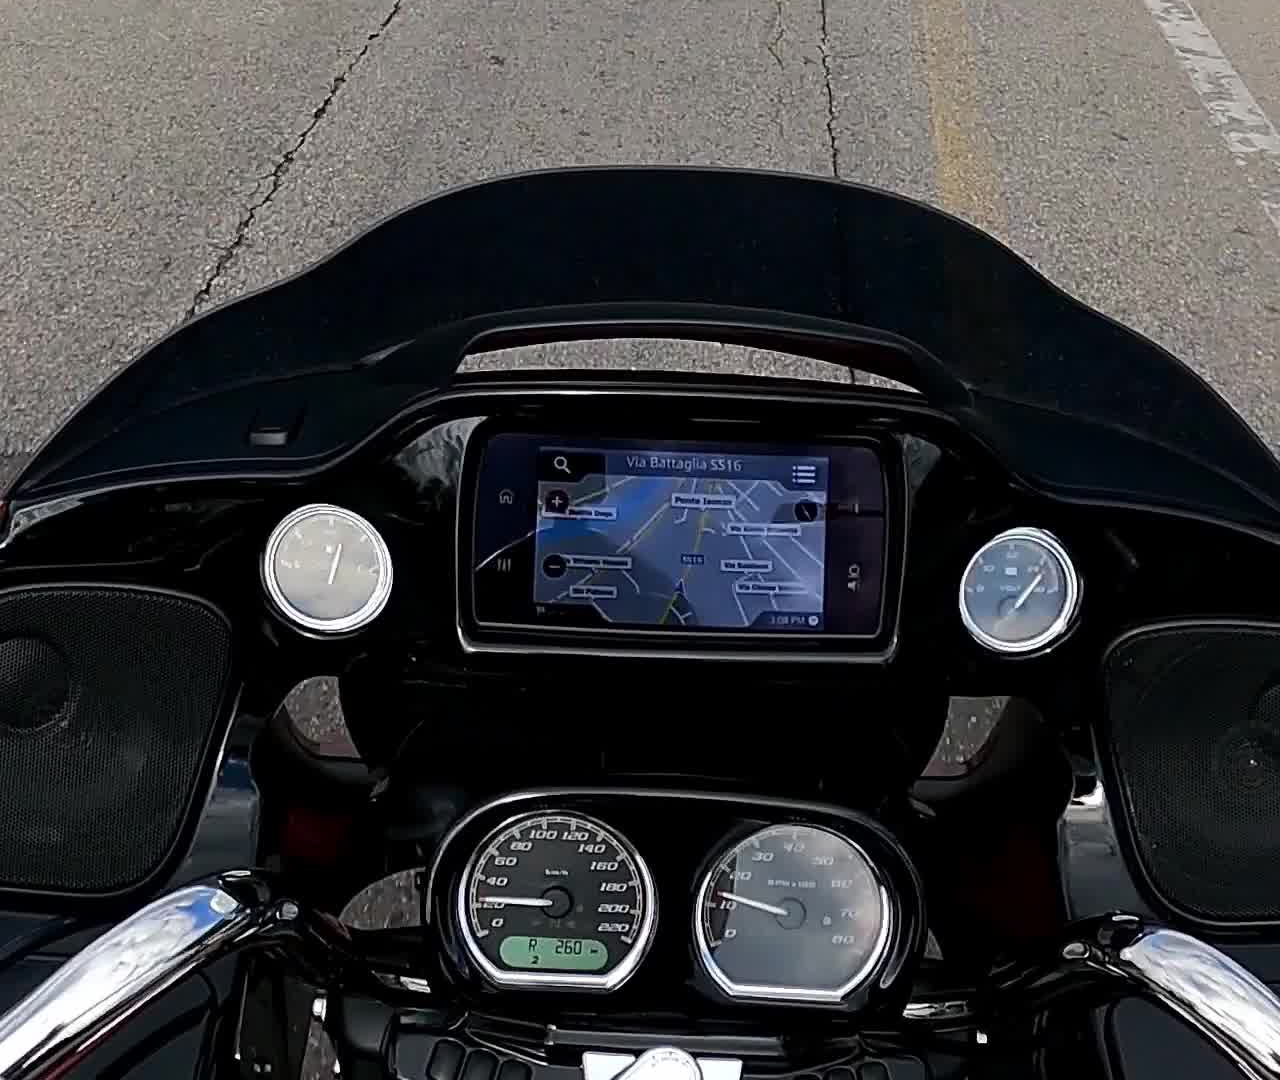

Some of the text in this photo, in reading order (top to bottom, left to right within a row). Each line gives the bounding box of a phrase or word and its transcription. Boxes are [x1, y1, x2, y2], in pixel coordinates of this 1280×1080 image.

[626, 455, 742, 473] Via Battaglia SS16
[529, 830, 557, 840] 100
[561, 831, 589, 841] 120
[510, 842, 532, 851] 80
[578, 844, 606, 854] 140
[783, 842, 806, 853] 40
[494, 857, 517, 866] 60
[752, 852, 775, 862] 30
[590, 861, 618, 871] 160
[486, 877, 508, 886] 40
[600, 882, 627, 892] 180
[598, 904, 630, 913] 200
[720, 900, 737, 910] 10
[491, 918, 504, 927] 0
[598, 923, 630, 932] 220
[724, 928, 737, 938] 0
[528, 939, 538, 952] R
[555, 940, 582, 955] 260
